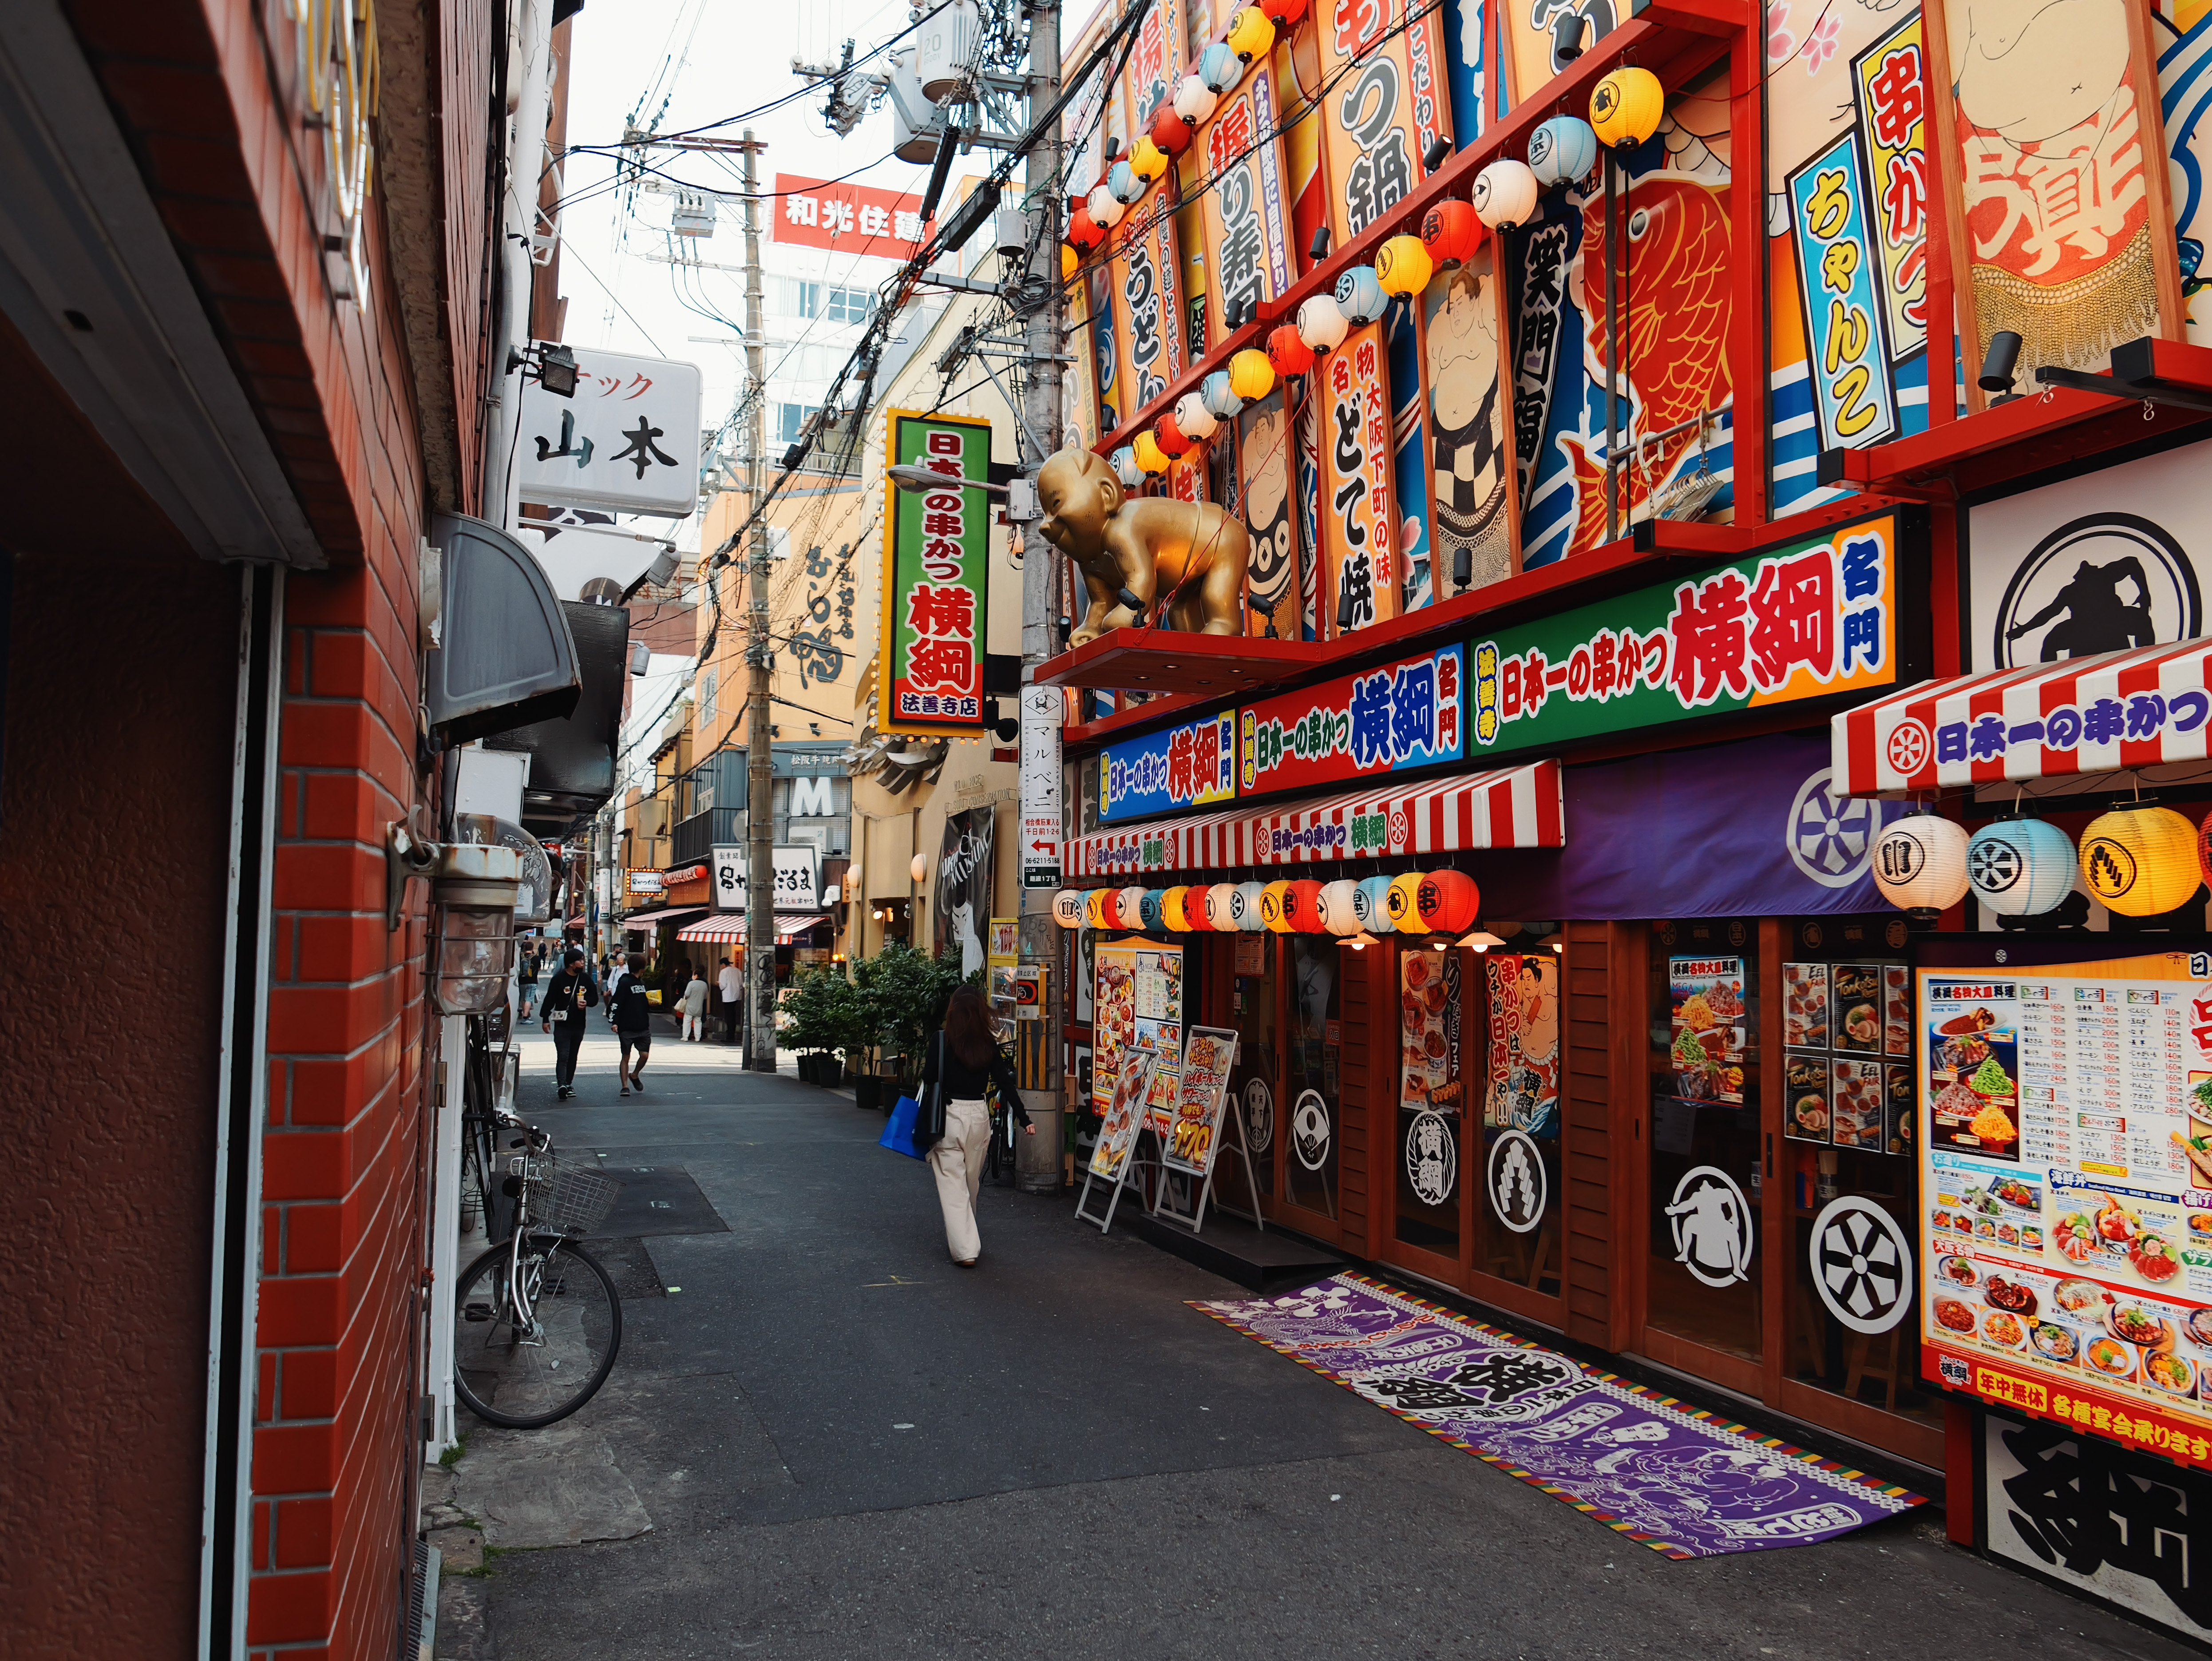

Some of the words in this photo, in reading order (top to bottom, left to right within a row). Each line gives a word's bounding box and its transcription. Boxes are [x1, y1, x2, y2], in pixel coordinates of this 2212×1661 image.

[785, 194, 926, 243] 和光住建
[1808, 170, 1877, 437] ちゃんこ
[1126, 250, 1166, 413] うどん
[1076, 285, 1095, 449] 本場新世界直伝の味
[534, 408, 679, 480] 山本
[1366, 384, 1392, 586] 大阪下町の味
[910, 585, 974, 691] 横綱
[1478, 646, 1496, 740] 法善寺
[1502, 633, 1668, 715] 日本一の串かつ
[1670, 551, 1835, 702] 横綱
[1842, 538, 1880, 672] 名門
[902, 694, 978, 716] 法善寺店
[1243, 712, 1256, 786] 法善寺
[1257, 710, 1349, 769] 日本一の串かつ
[1350, 662, 1436, 766] 横綱
[1438, 657, 1457, 751] 名門
[1936, 690, 2210, 765] 日本一の串かつ
[1033, 726, 1052, 807] マルベニ
[1101, 755, 1109, 814] 法善寺
[1111, 753, 1167, 801] 日本一の串かつ
[1168, 725, 1218, 800] 横綱
[1220, 720, 1232, 790] 名門
[791, 777, 835, 817] M
[1271, 823, 1347, 851] 日本一の串かつ
[1351, 813, 1387, 849] 横綱
[1096, 848, 1141, 867] 日本一の串かつ
[1143, 839, 1163, 866] 横綱
[1500, 958, 1522, 1054] 串かつは
[1488, 960, 1508, 1124] ウチが日本一や!!
[1184, 1069, 1213, 1086] ハイボール
[2103, 1089, 2121, 1097] 300円
[2165, 1074, 2182, 1082] 160円
[2165, 1085, 2183, 1093] 180円
[2103, 1101, 2121, 1109] 320円
[2165, 1095, 2183, 1104] 180円
[2165, 1106, 2184, 1115] 280円
[2110, 1133, 2126, 1142] 130円
[2110, 1143, 2127, 1152] 150円
[2167, 1141, 2184, 1150] 150円
[2110, 1154, 2127, 1162] 150円
[2167, 1151, 2184, 1160] 130円
[2167, 1162, 2185, 1171] 180円
[2050, 1169, 2086, 1188] 海鮮丼
[1934, 1239, 1975, 1257] 大阪名物
[1979, 1372, 2045, 1408] 年中無休
